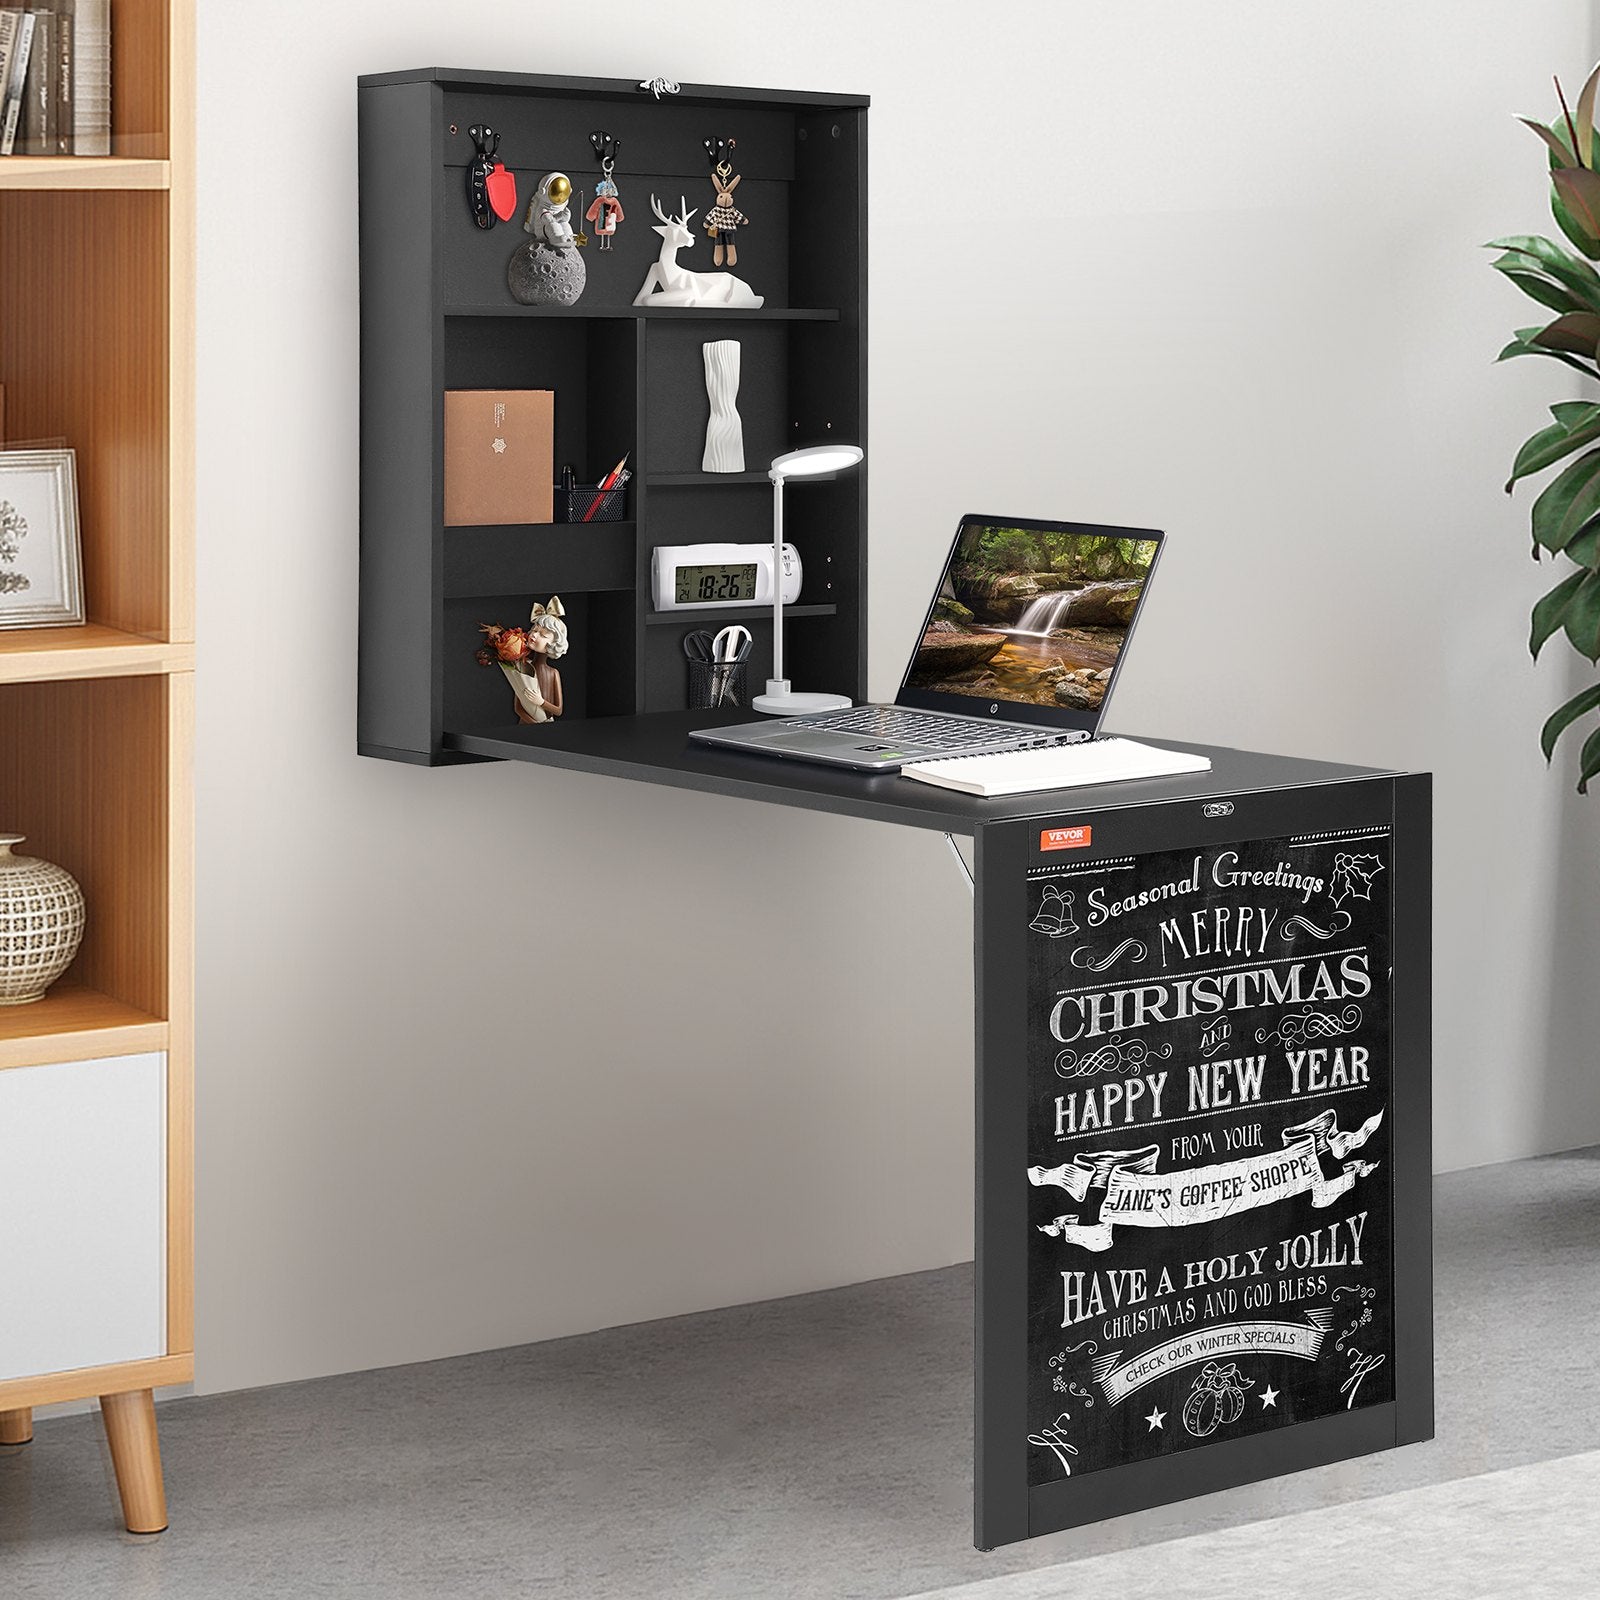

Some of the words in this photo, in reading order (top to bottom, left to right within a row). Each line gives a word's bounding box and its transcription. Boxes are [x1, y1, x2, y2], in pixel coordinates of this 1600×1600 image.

[698, 574, 741, 600] 18:26
[1048, 829, 1084, 842] VEVOR
[1087, 856, 1202, 927] Seasonal
[1212, 851, 1324, 904] Greetings
[1158, 906, 1279, 968] MERRY
[1049, 954, 1372, 1043] CHRISTMAS
[1199, 1023, 1232, 1050] AND
[1054, 1071, 1168, 1136] HAPPY
[1188, 1055, 1267, 1112] NEW
[1285, 1046, 1371, 1095] YEAR
[1171, 1132, 1216, 1161] FROM
[1223, 1123, 1264, 1151] YOUR
[1111, 1187, 1172, 1211] JANE'S
[1180, 1176, 1243, 1207] COFFEE
[1250, 1155, 1312, 1193] SHOPPE
[1060, 1268, 1148, 1328] HAVE
[1154, 1266, 1176, 1297] A
[1183, 1247, 1268, 1290] HOLY
[1275, 1211, 1368, 1271] JOLLY
[1103, 1297, 1196, 1341] CHRISTMAS
[1203, 1288, 1238, 1320] AND
[1244, 1280, 1273, 1310] GOD
[1279, 1275, 1328, 1304] BLESS
[1125, 1355, 1167, 1383] CHECK
[1168, 1344, 1193, 1361] OUR
[1197, 1332, 1241, 1351] WINTER
[1244, 1331, 1297, 1345] SPECIALS
